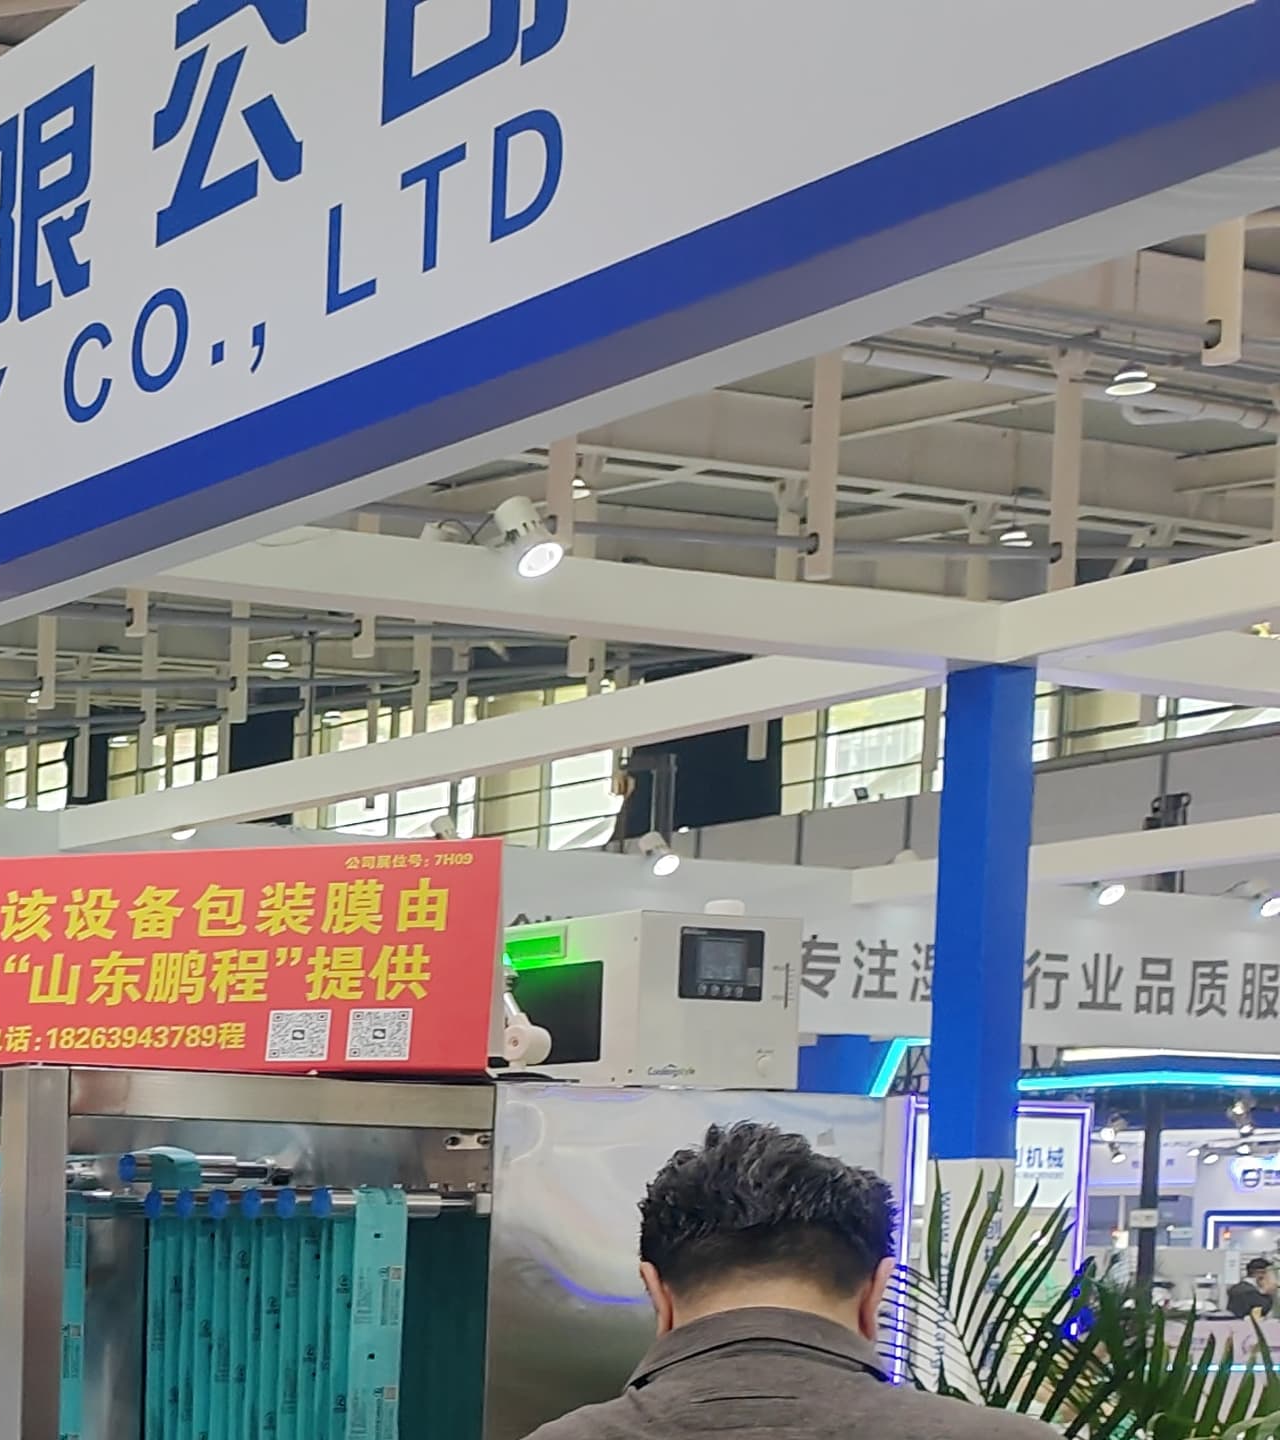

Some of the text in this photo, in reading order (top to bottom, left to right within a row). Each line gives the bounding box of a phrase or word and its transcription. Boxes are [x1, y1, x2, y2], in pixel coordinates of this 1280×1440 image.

[62, 288, 268, 424] CO.,
[325, 108, 564, 316] LTD
[434, 853, 473, 866] 7H09
[0, 879, 450, 943] 该设备包装膜由
[3, 944, 432, 1006] “山东鹏程”提供
[1023, 949, 1280, 1021] 行业品质服
